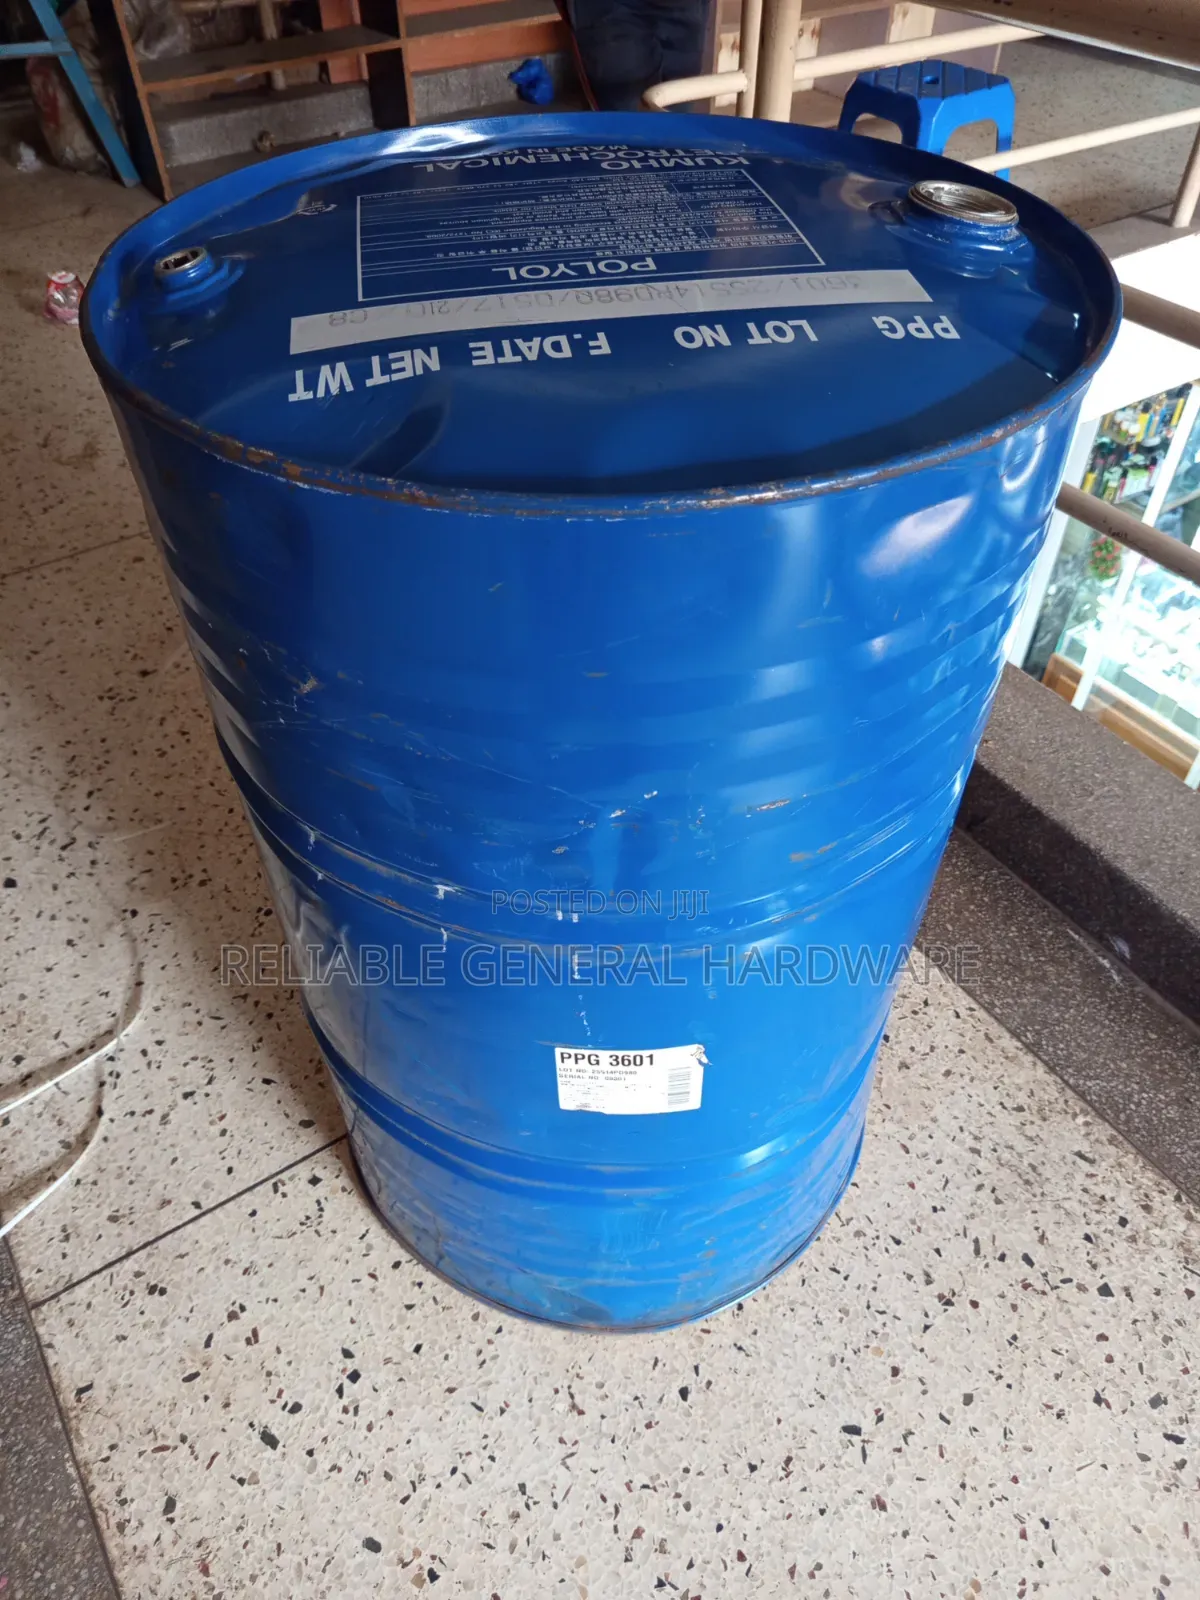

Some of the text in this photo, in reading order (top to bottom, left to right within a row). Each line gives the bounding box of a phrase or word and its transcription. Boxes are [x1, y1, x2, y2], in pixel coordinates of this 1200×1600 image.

[600, 155, 750, 170] KUMHO
[492, 257, 657, 280] POLYOL
[288, 315, 961, 402] PPG LOT NO F.DATE NET WT
[560, 1051, 654, 1067] PPG 3601
